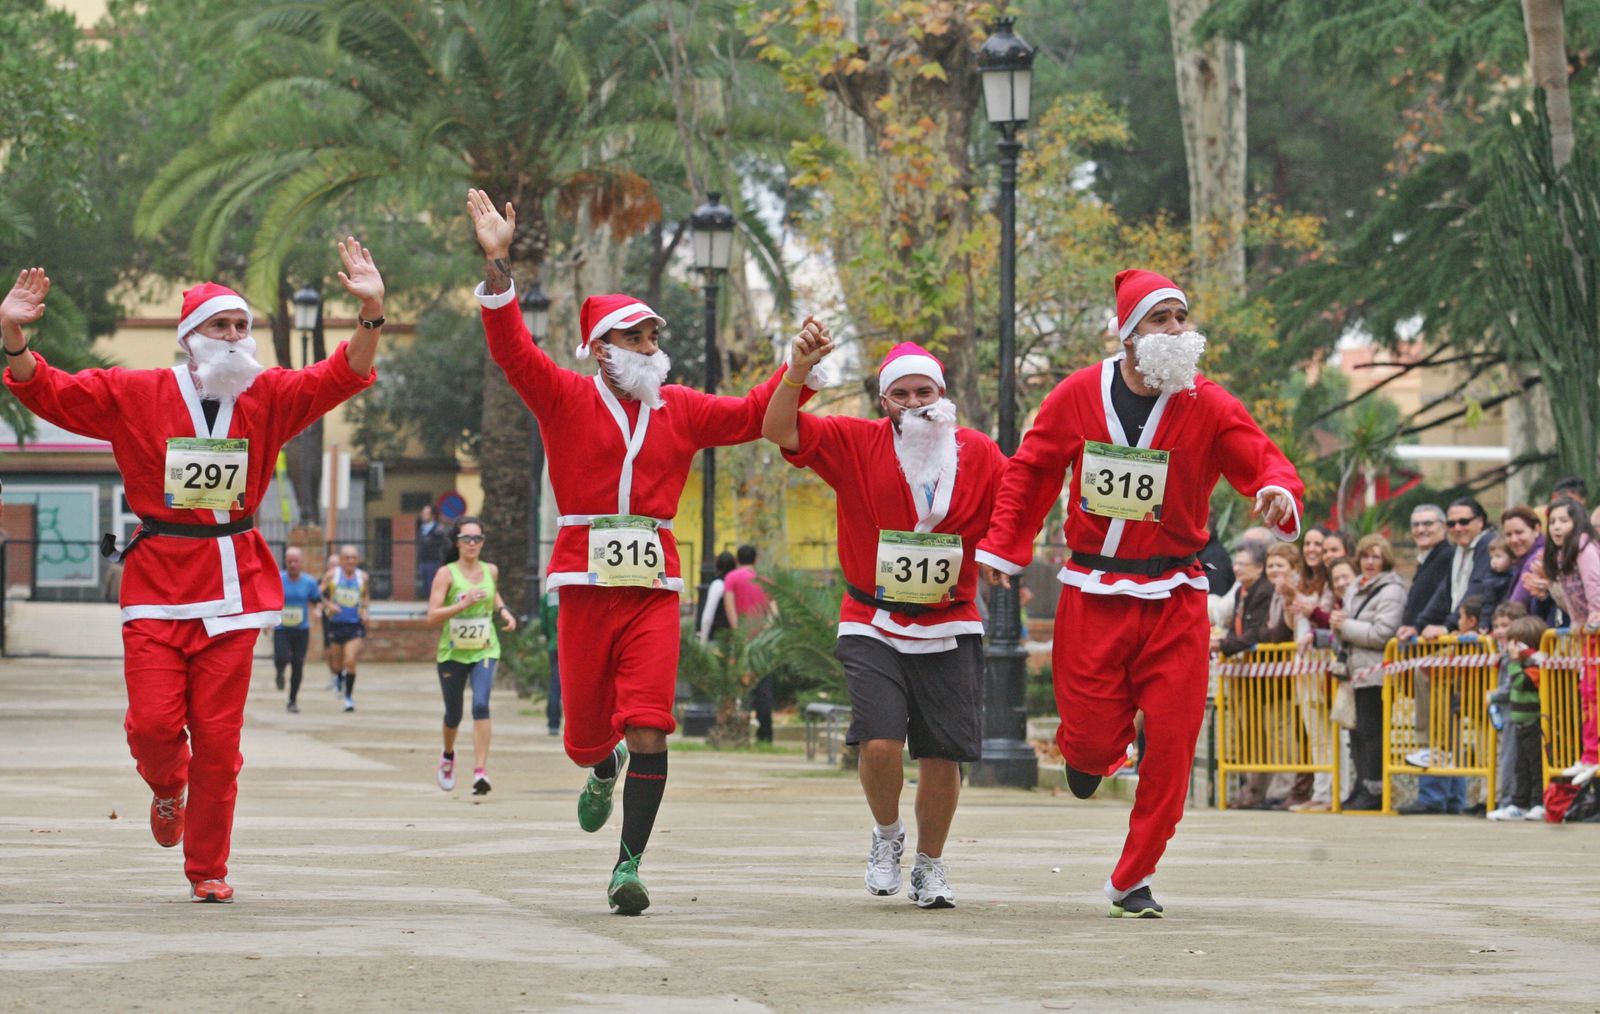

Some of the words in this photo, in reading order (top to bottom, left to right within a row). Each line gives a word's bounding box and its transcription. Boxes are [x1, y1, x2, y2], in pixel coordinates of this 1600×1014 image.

[184, 462, 239, 490] 297
[1097, 469, 1154, 501] 318
[607, 540, 658, 568] 315
[894, 556, 950, 584] 313
[458, 625, 485, 640] 227
